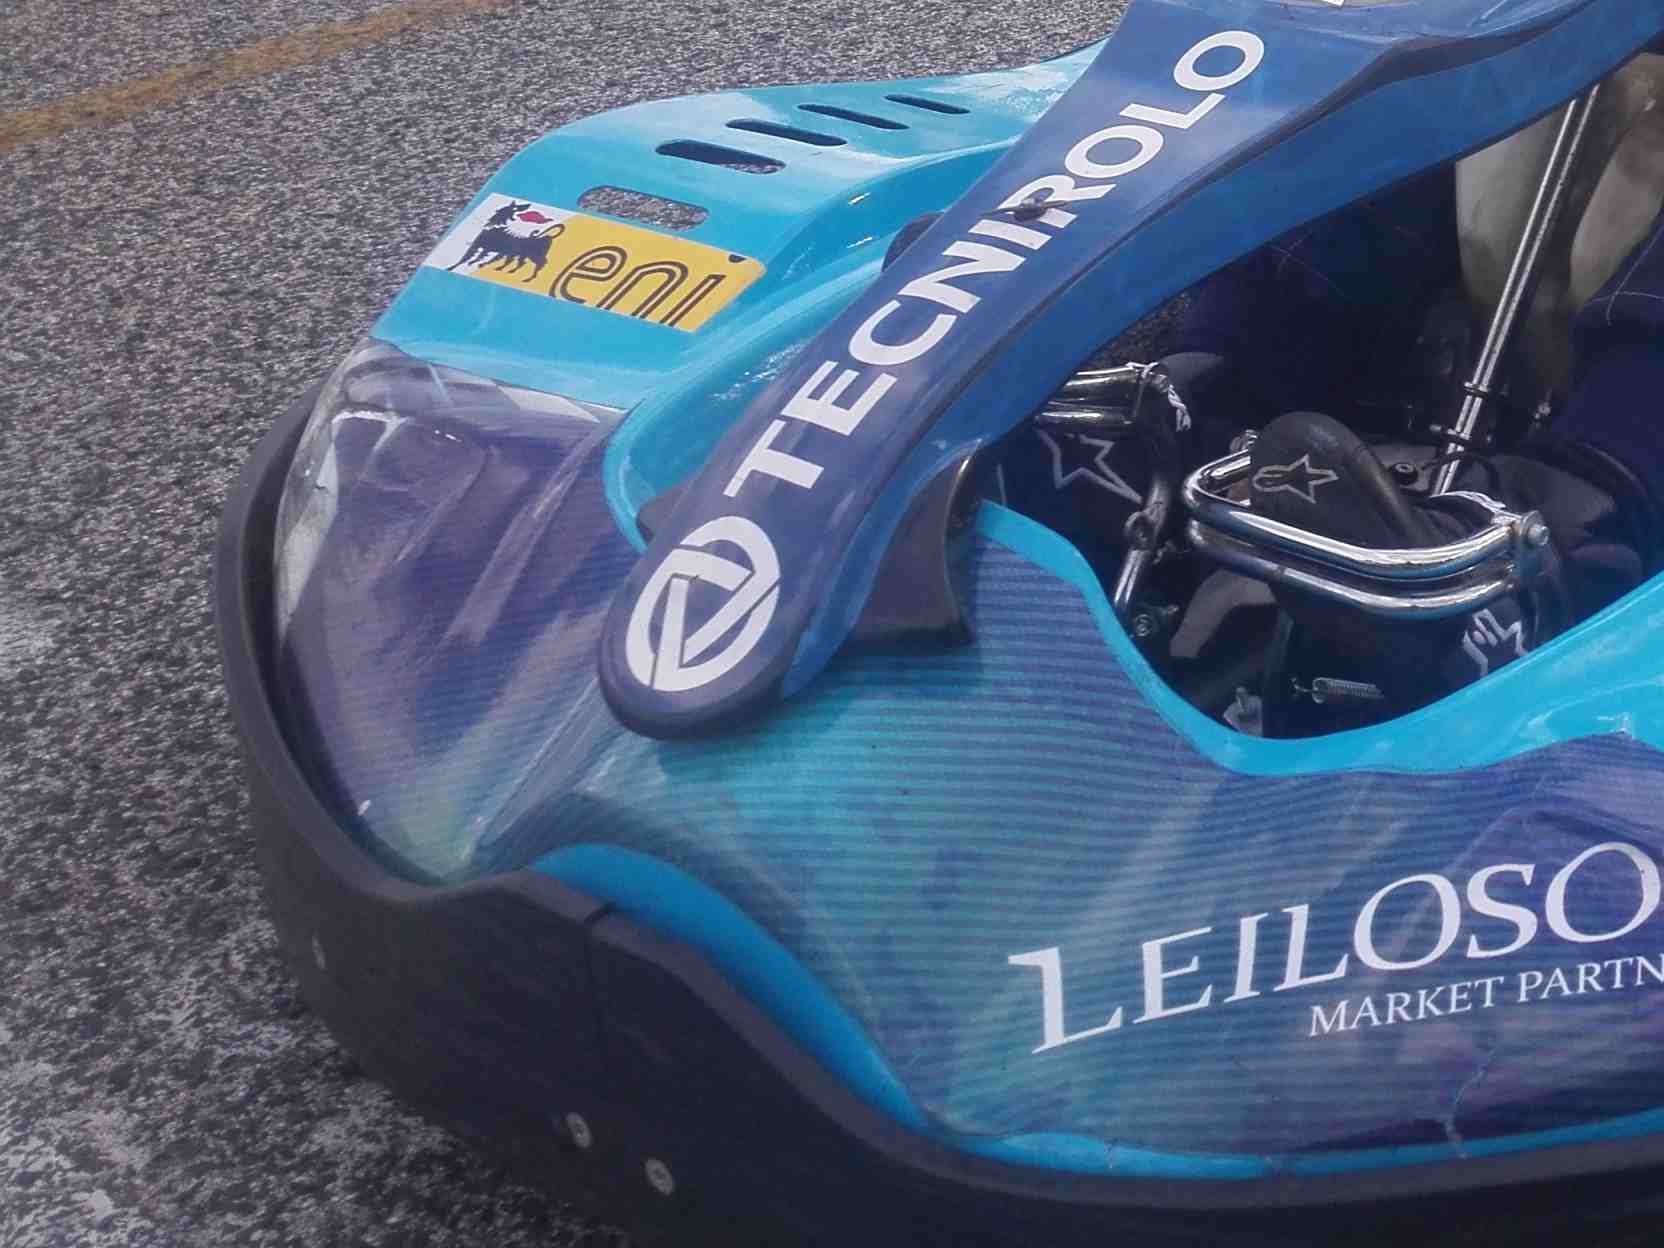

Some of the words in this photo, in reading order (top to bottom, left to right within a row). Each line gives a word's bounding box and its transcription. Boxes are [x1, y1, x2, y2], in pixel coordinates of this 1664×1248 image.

[550, 245, 747, 328] eni
[723, 30, 1265, 497] TECNIROLO
[1309, 977, 1505, 1037] MARKET
